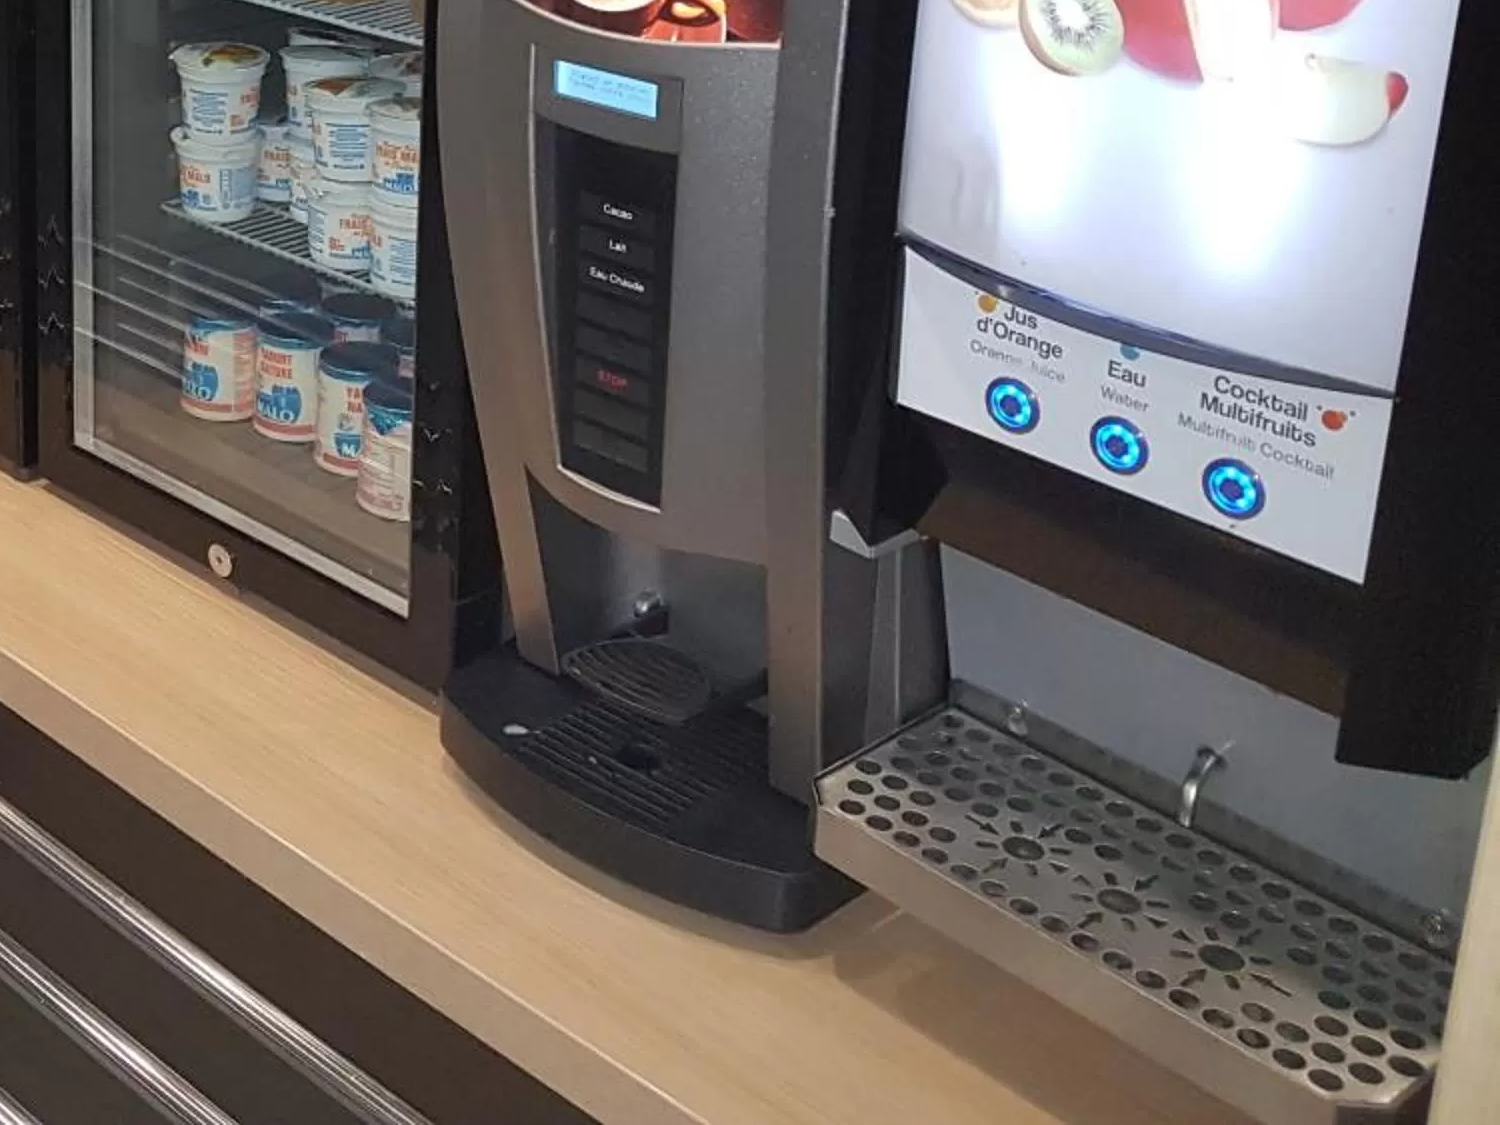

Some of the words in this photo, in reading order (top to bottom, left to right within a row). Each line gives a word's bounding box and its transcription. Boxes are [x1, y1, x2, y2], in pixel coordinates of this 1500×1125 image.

[589, 266, 608, 281] Eau
[609, 273, 645, 293] Chaude
[1004, 306, 1038, 329] Jus
[976, 316, 1063, 359] d'Orange
[1108, 359, 1147, 388] Eau
[1100, 385, 1150, 411] Water
[1214, 375, 1309, 421] Cocktail
[1200, 391, 1316, 447] Multifruits
[1259, 442, 1335, 480] Cocktail
